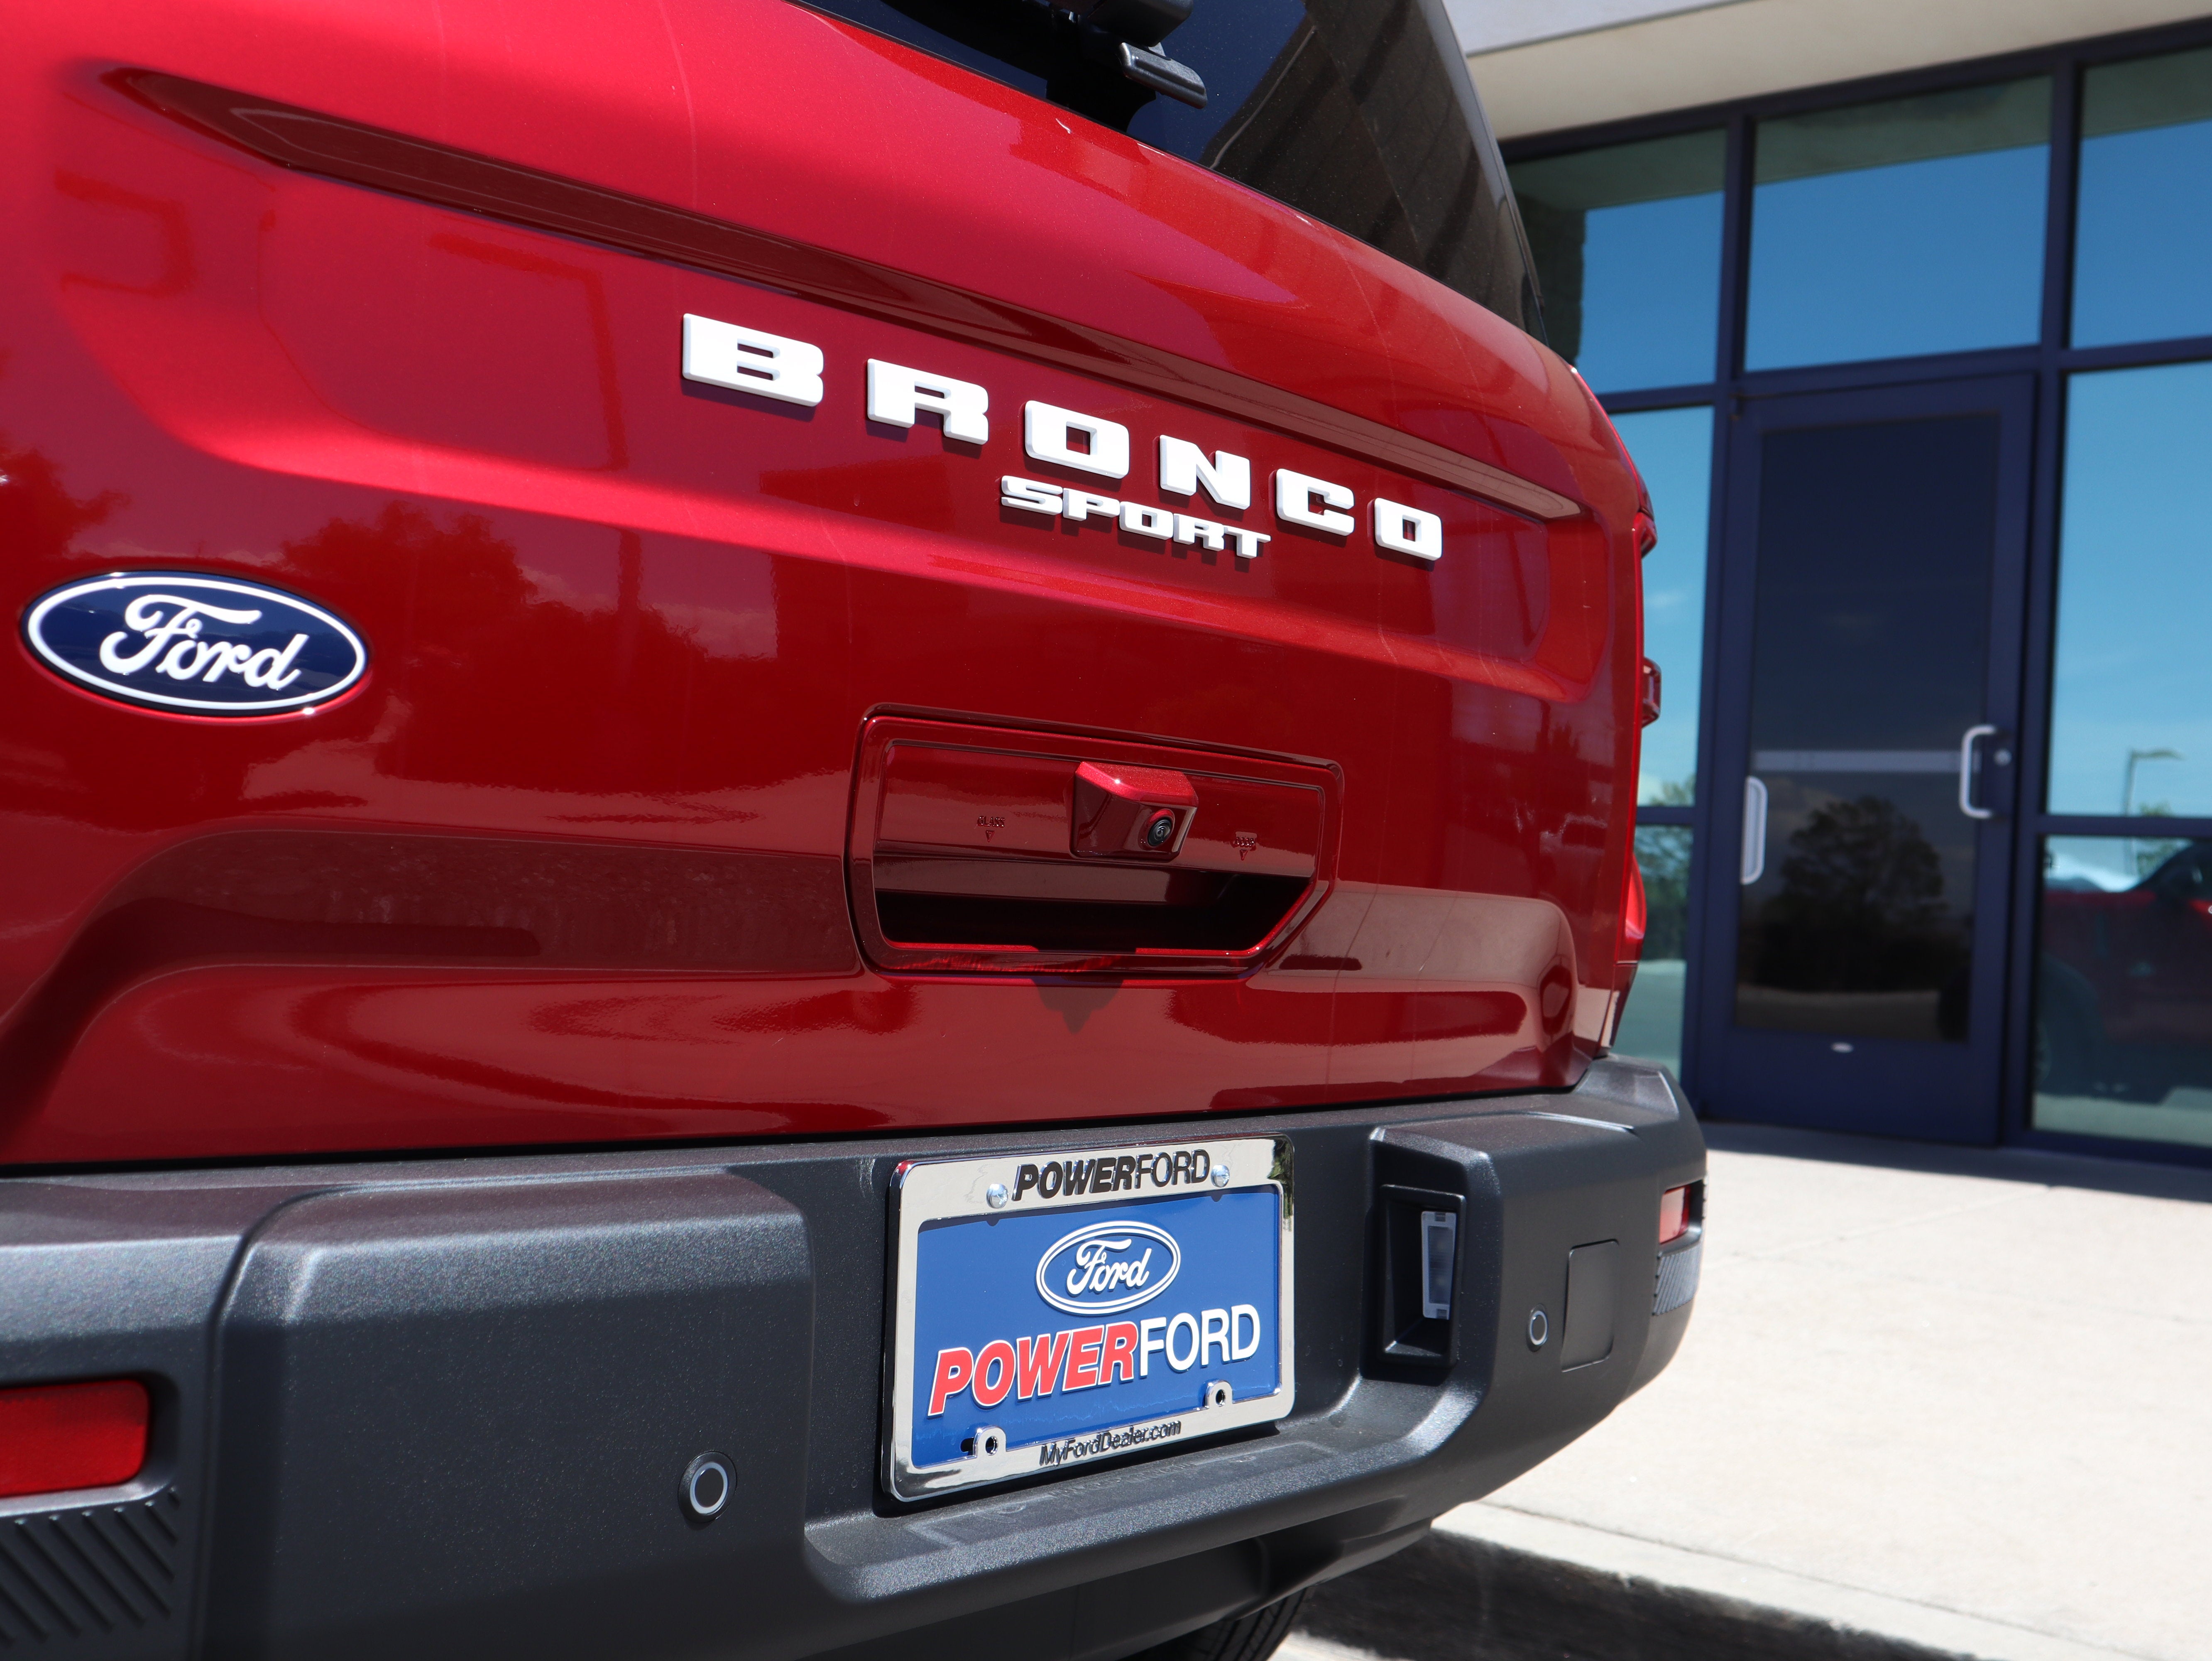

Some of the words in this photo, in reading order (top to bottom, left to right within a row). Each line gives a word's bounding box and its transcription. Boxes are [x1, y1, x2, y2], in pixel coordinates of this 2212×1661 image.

[682, 313, 1442, 561] BRONCO
[1000, 475, 1271, 559] SPORT
[100, 594, 309, 689] Ford
[1066, 1238, 1152, 1296] Ford
[1039, 1420, 1182, 1467] MyFordDealer.com
